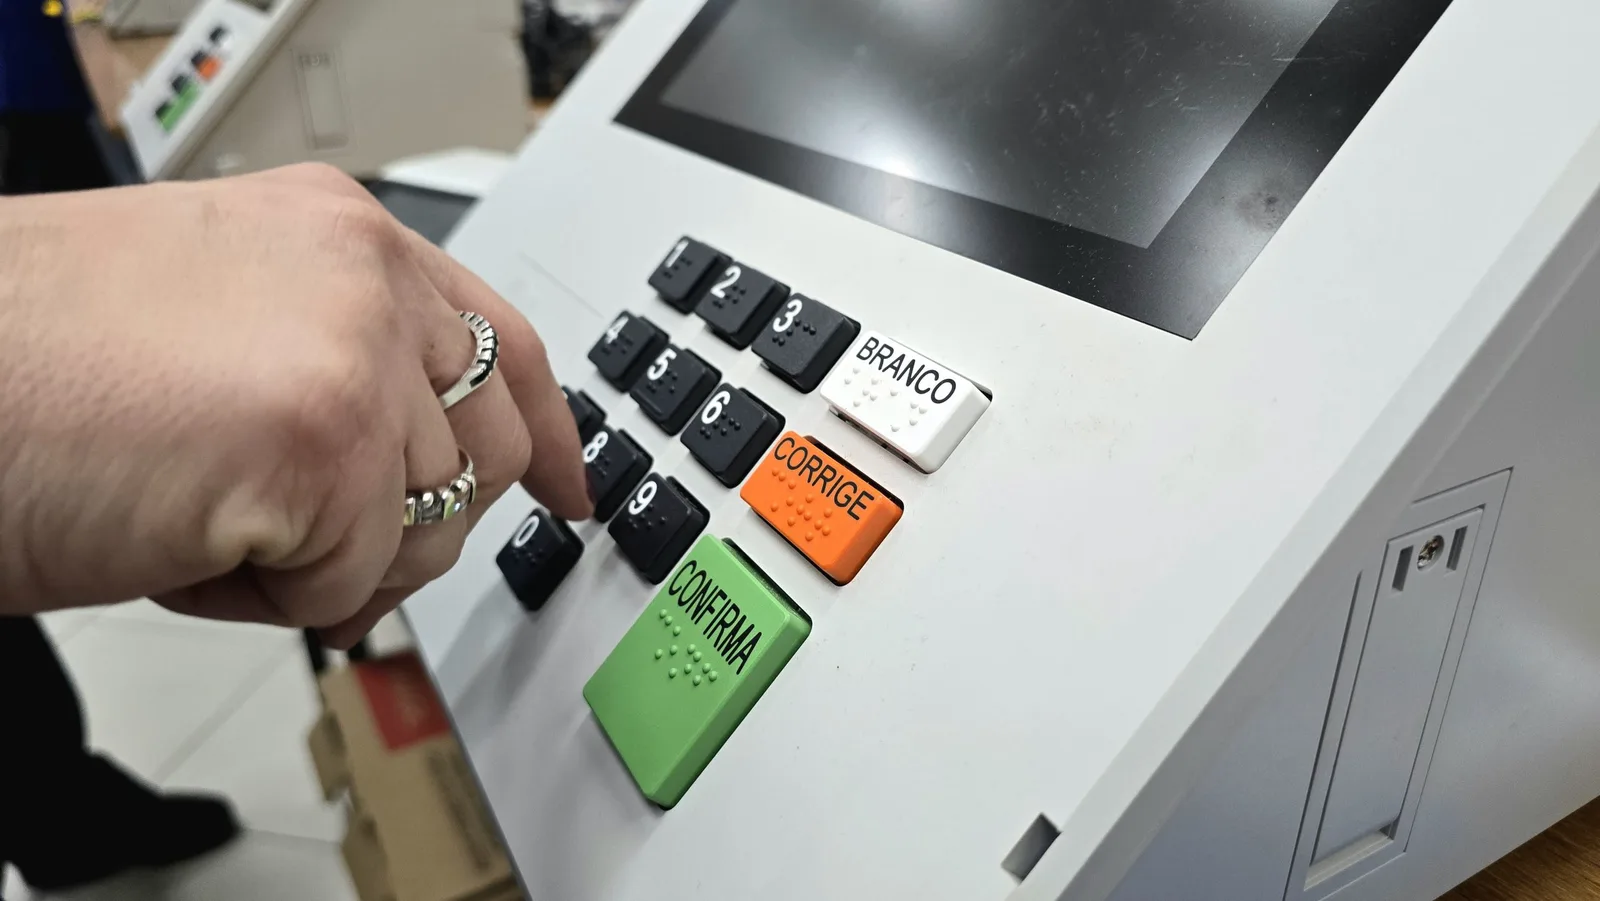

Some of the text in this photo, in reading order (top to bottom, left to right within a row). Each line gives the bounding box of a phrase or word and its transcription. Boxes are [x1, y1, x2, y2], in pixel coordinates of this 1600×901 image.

[664, 241, 689, 268] 1
[710, 265, 742, 299] 2
[604, 315, 630, 345] 4
[773, 298, 803, 333] 3
[647, 348, 677, 380] 5
[856, 337, 957, 404] BRANCO
[701, 390, 730, 424] 6
[582, 431, 608, 463] 8
[773, 437, 875, 521] CORRIGE
[628, 480, 658, 515] 9
[514, 515, 540, 548] 0
[668, 560, 763, 676] CONFIRMA
